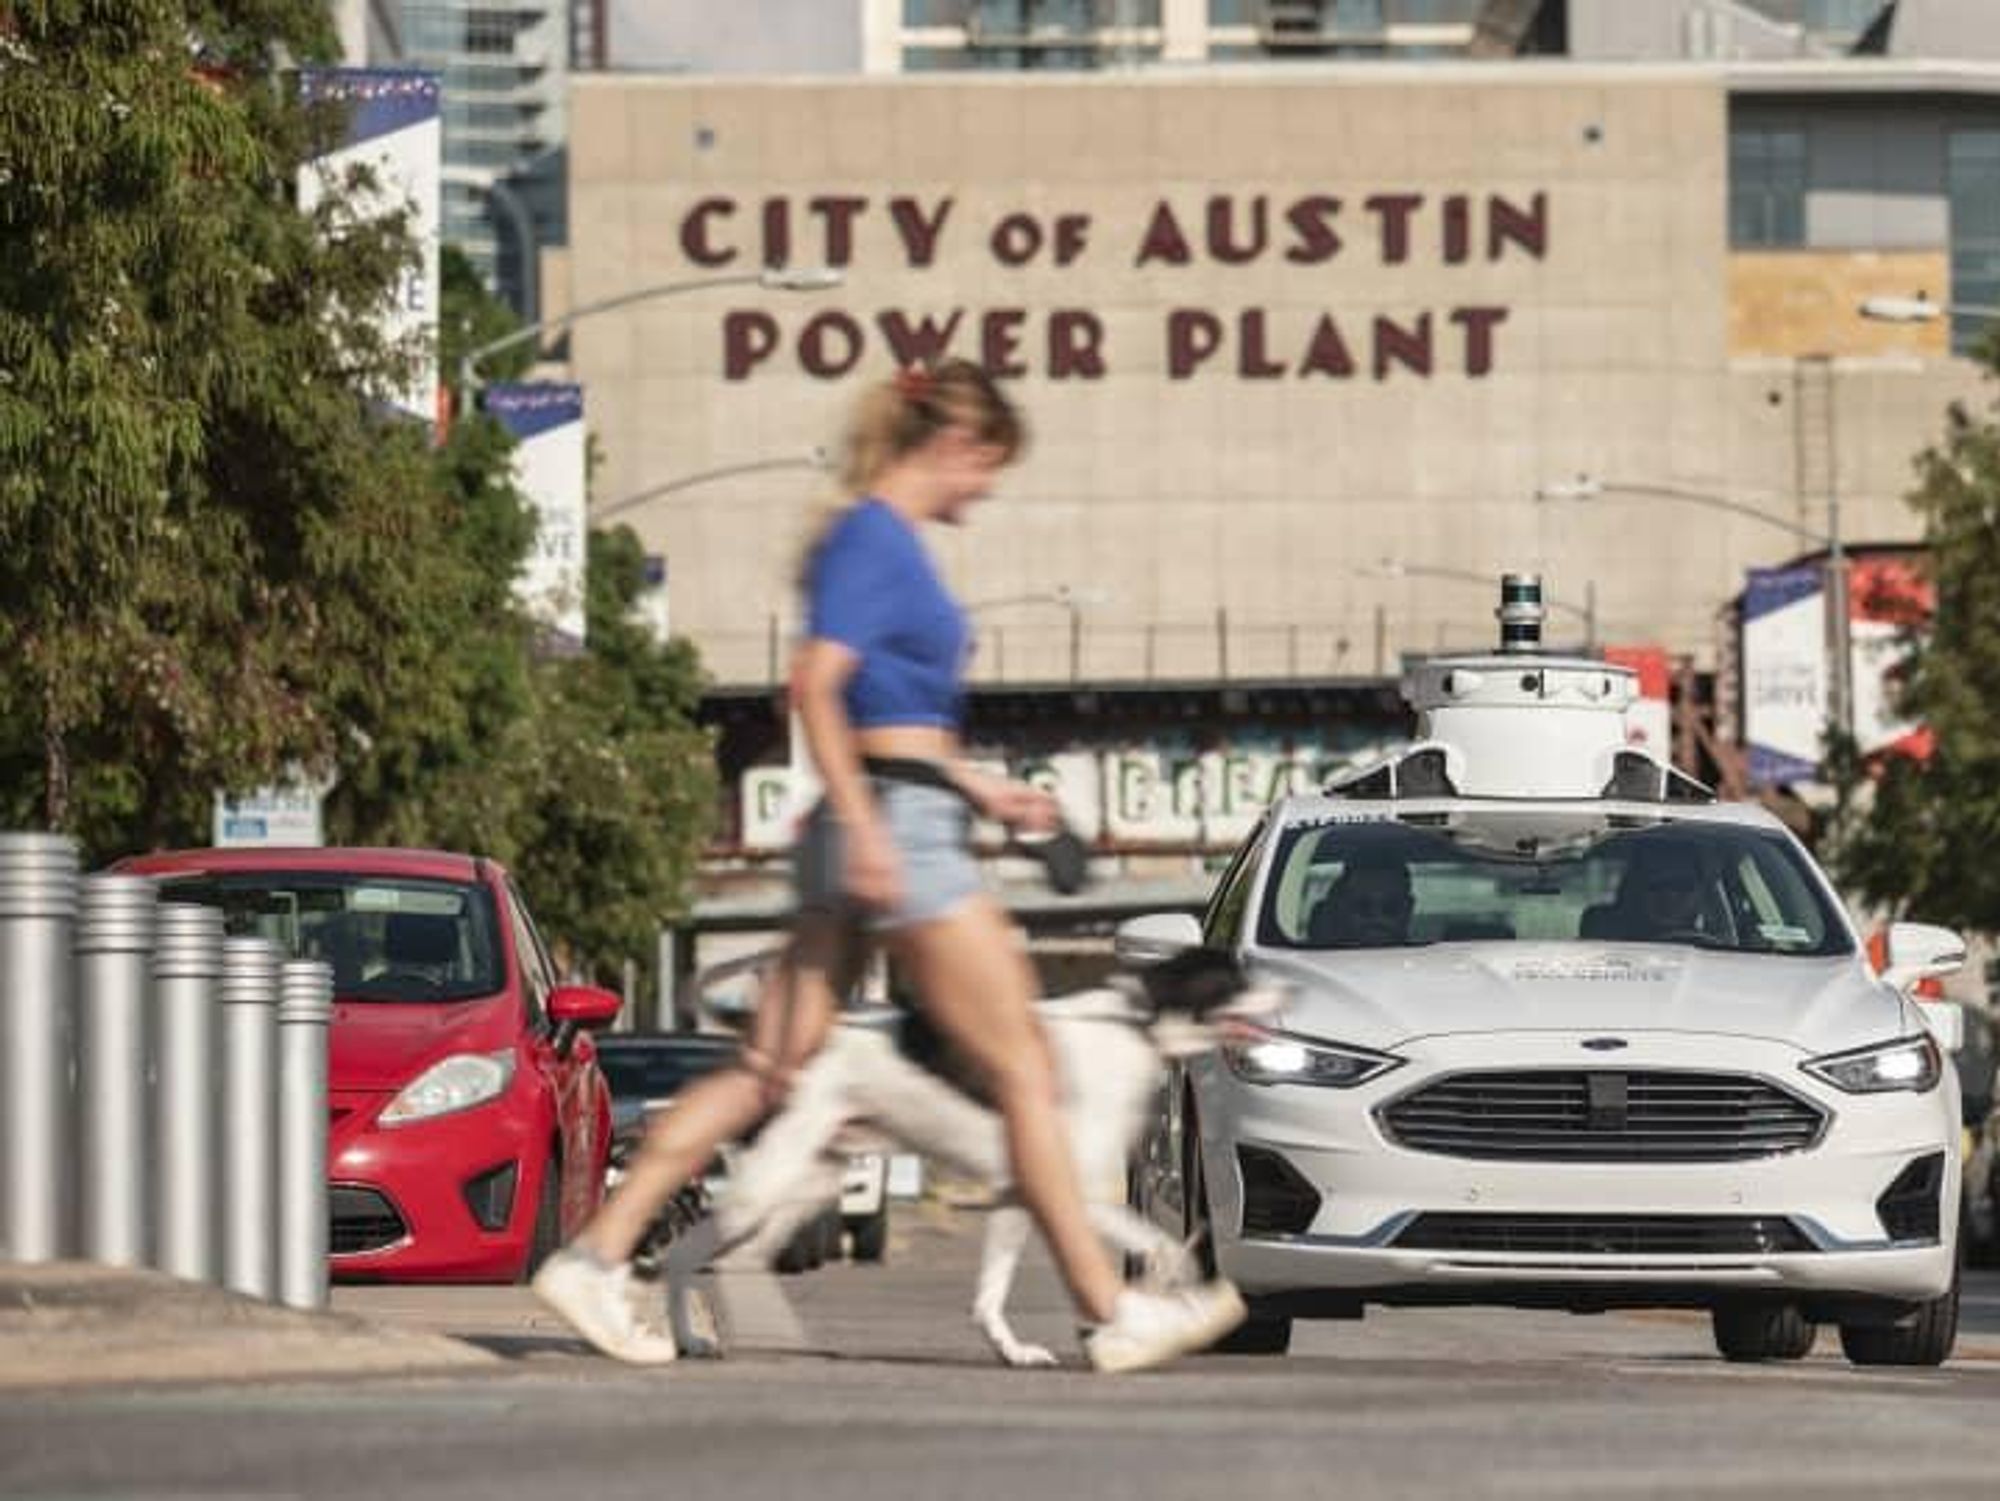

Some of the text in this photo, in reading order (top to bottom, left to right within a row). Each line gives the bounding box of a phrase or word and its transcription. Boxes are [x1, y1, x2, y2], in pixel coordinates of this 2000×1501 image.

[679, 192, 1547, 267] CITY OF AUSTIN
[723, 306, 1508, 381] POWER PLANT
